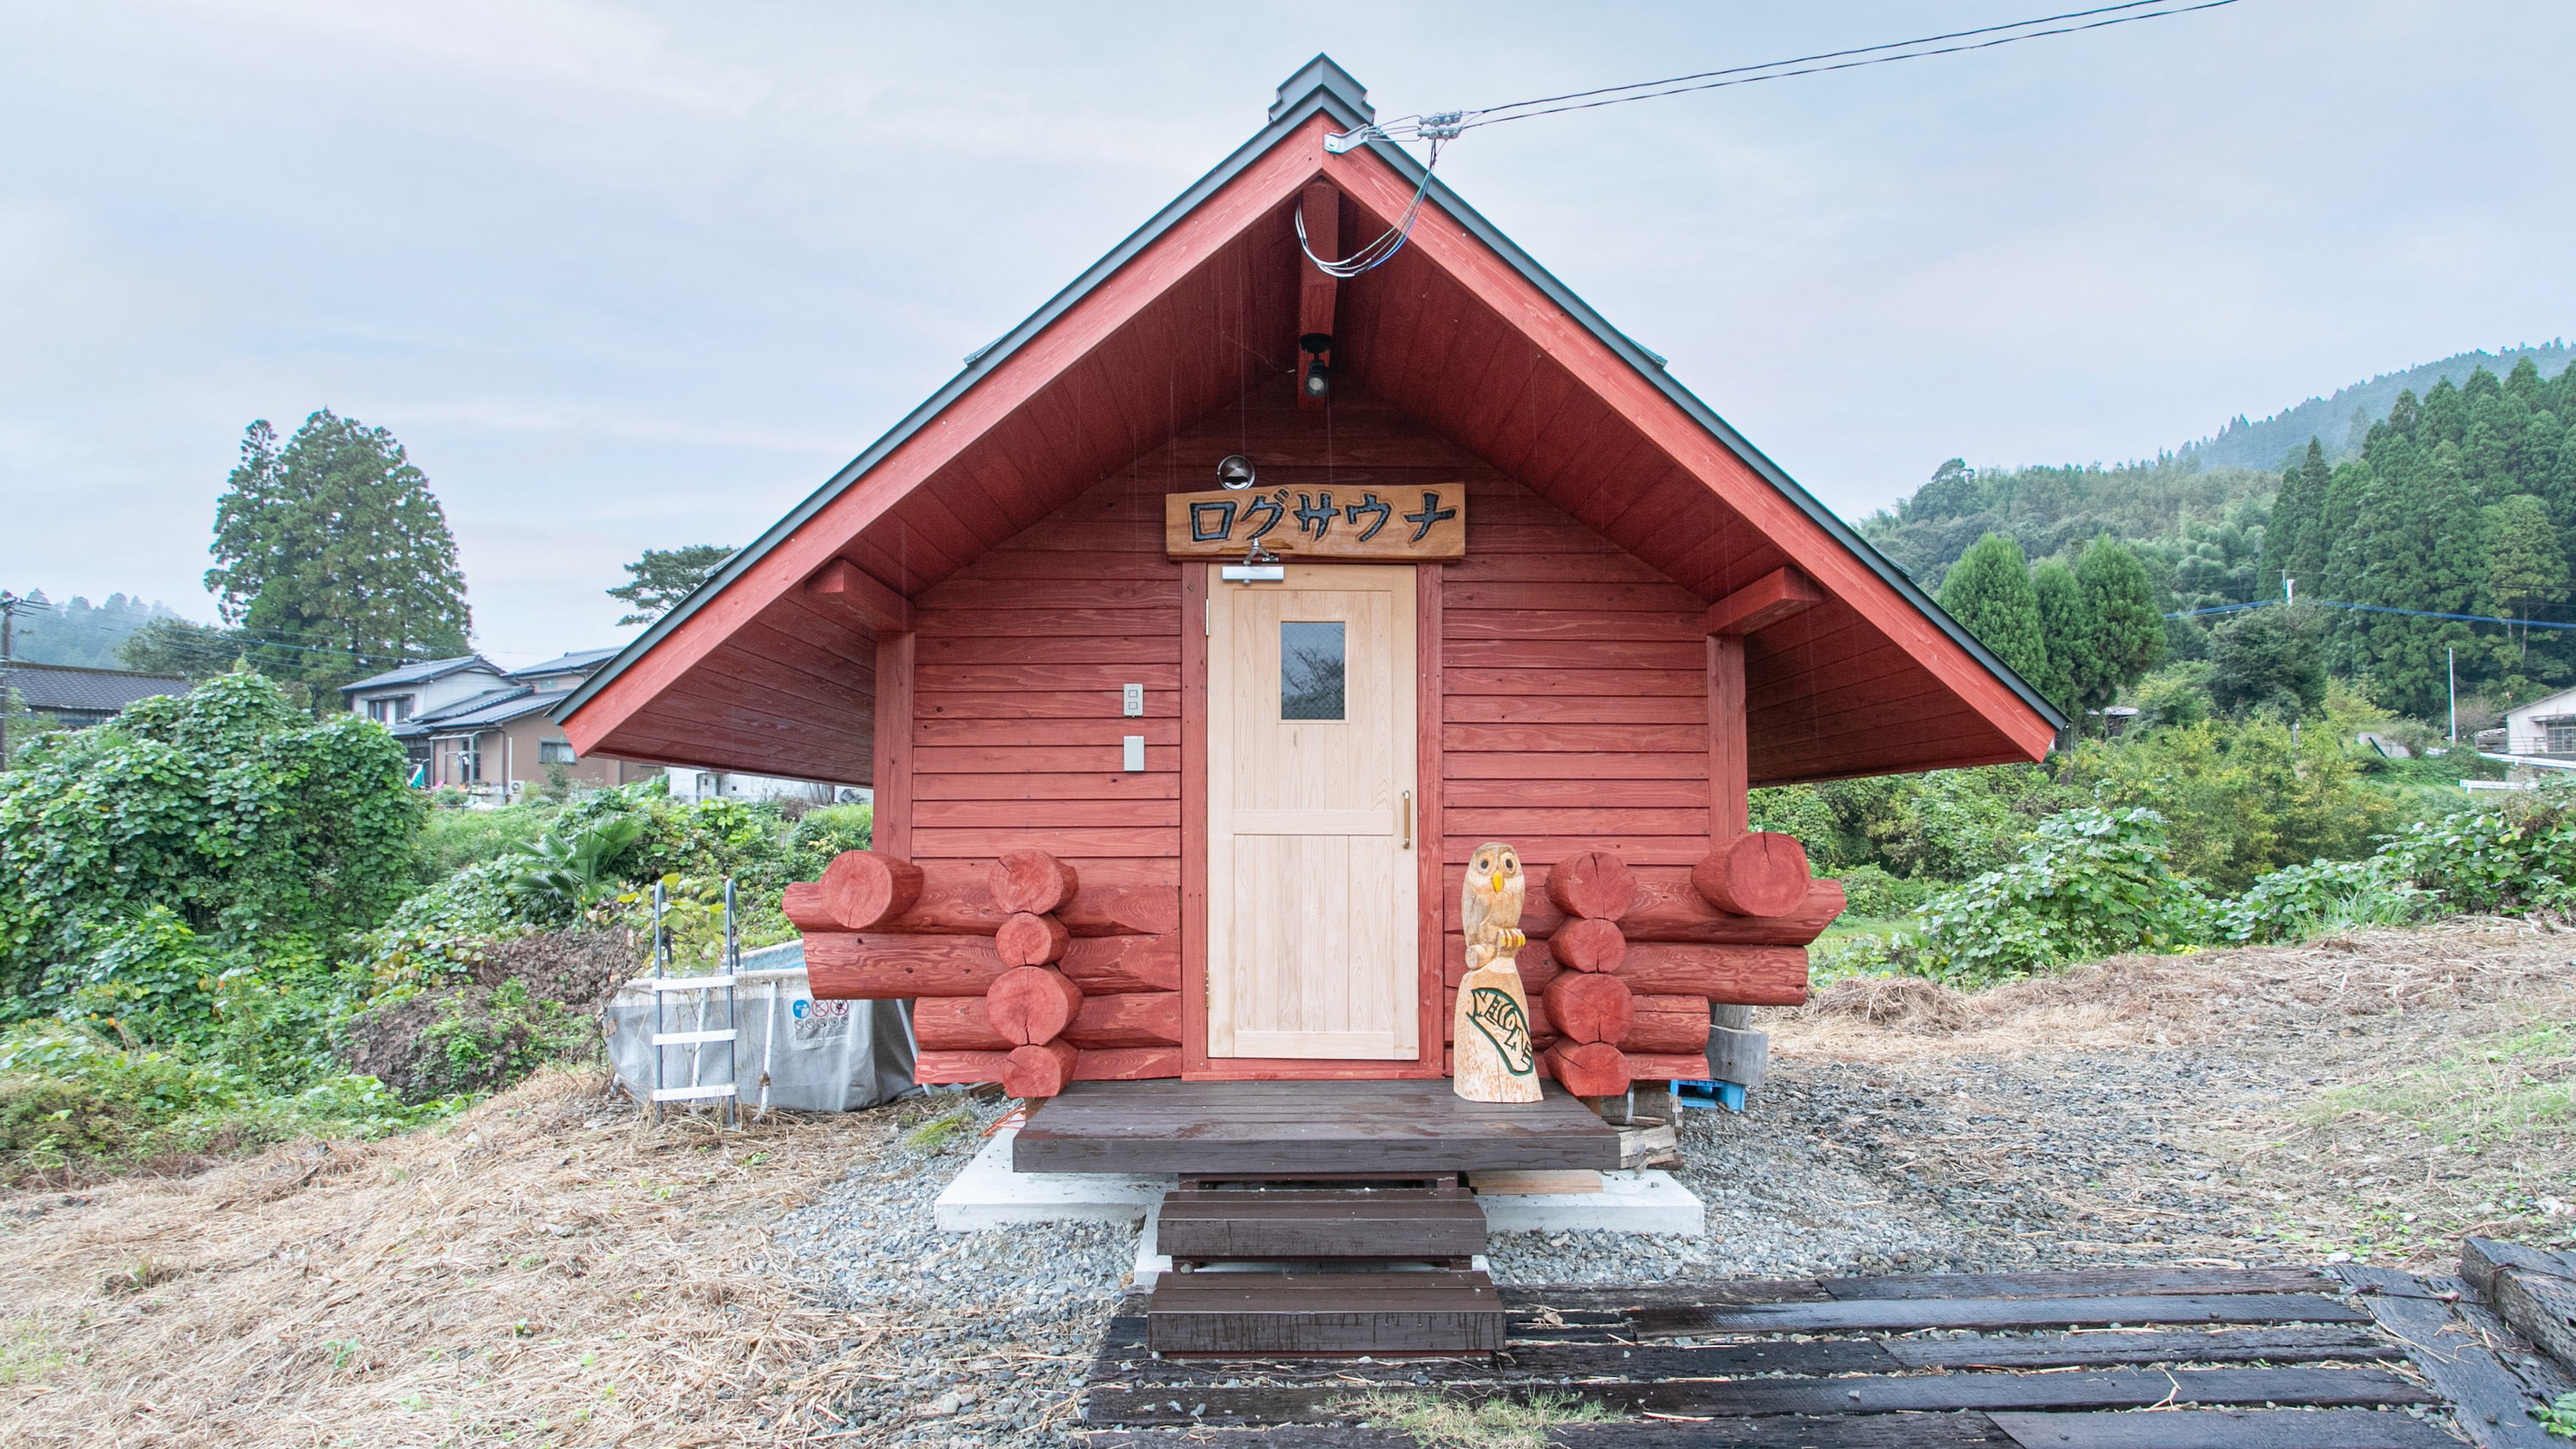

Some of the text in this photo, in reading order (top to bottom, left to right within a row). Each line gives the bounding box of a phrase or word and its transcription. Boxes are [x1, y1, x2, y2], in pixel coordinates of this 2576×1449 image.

[1189, 489, 1457, 542] ログサウナ
